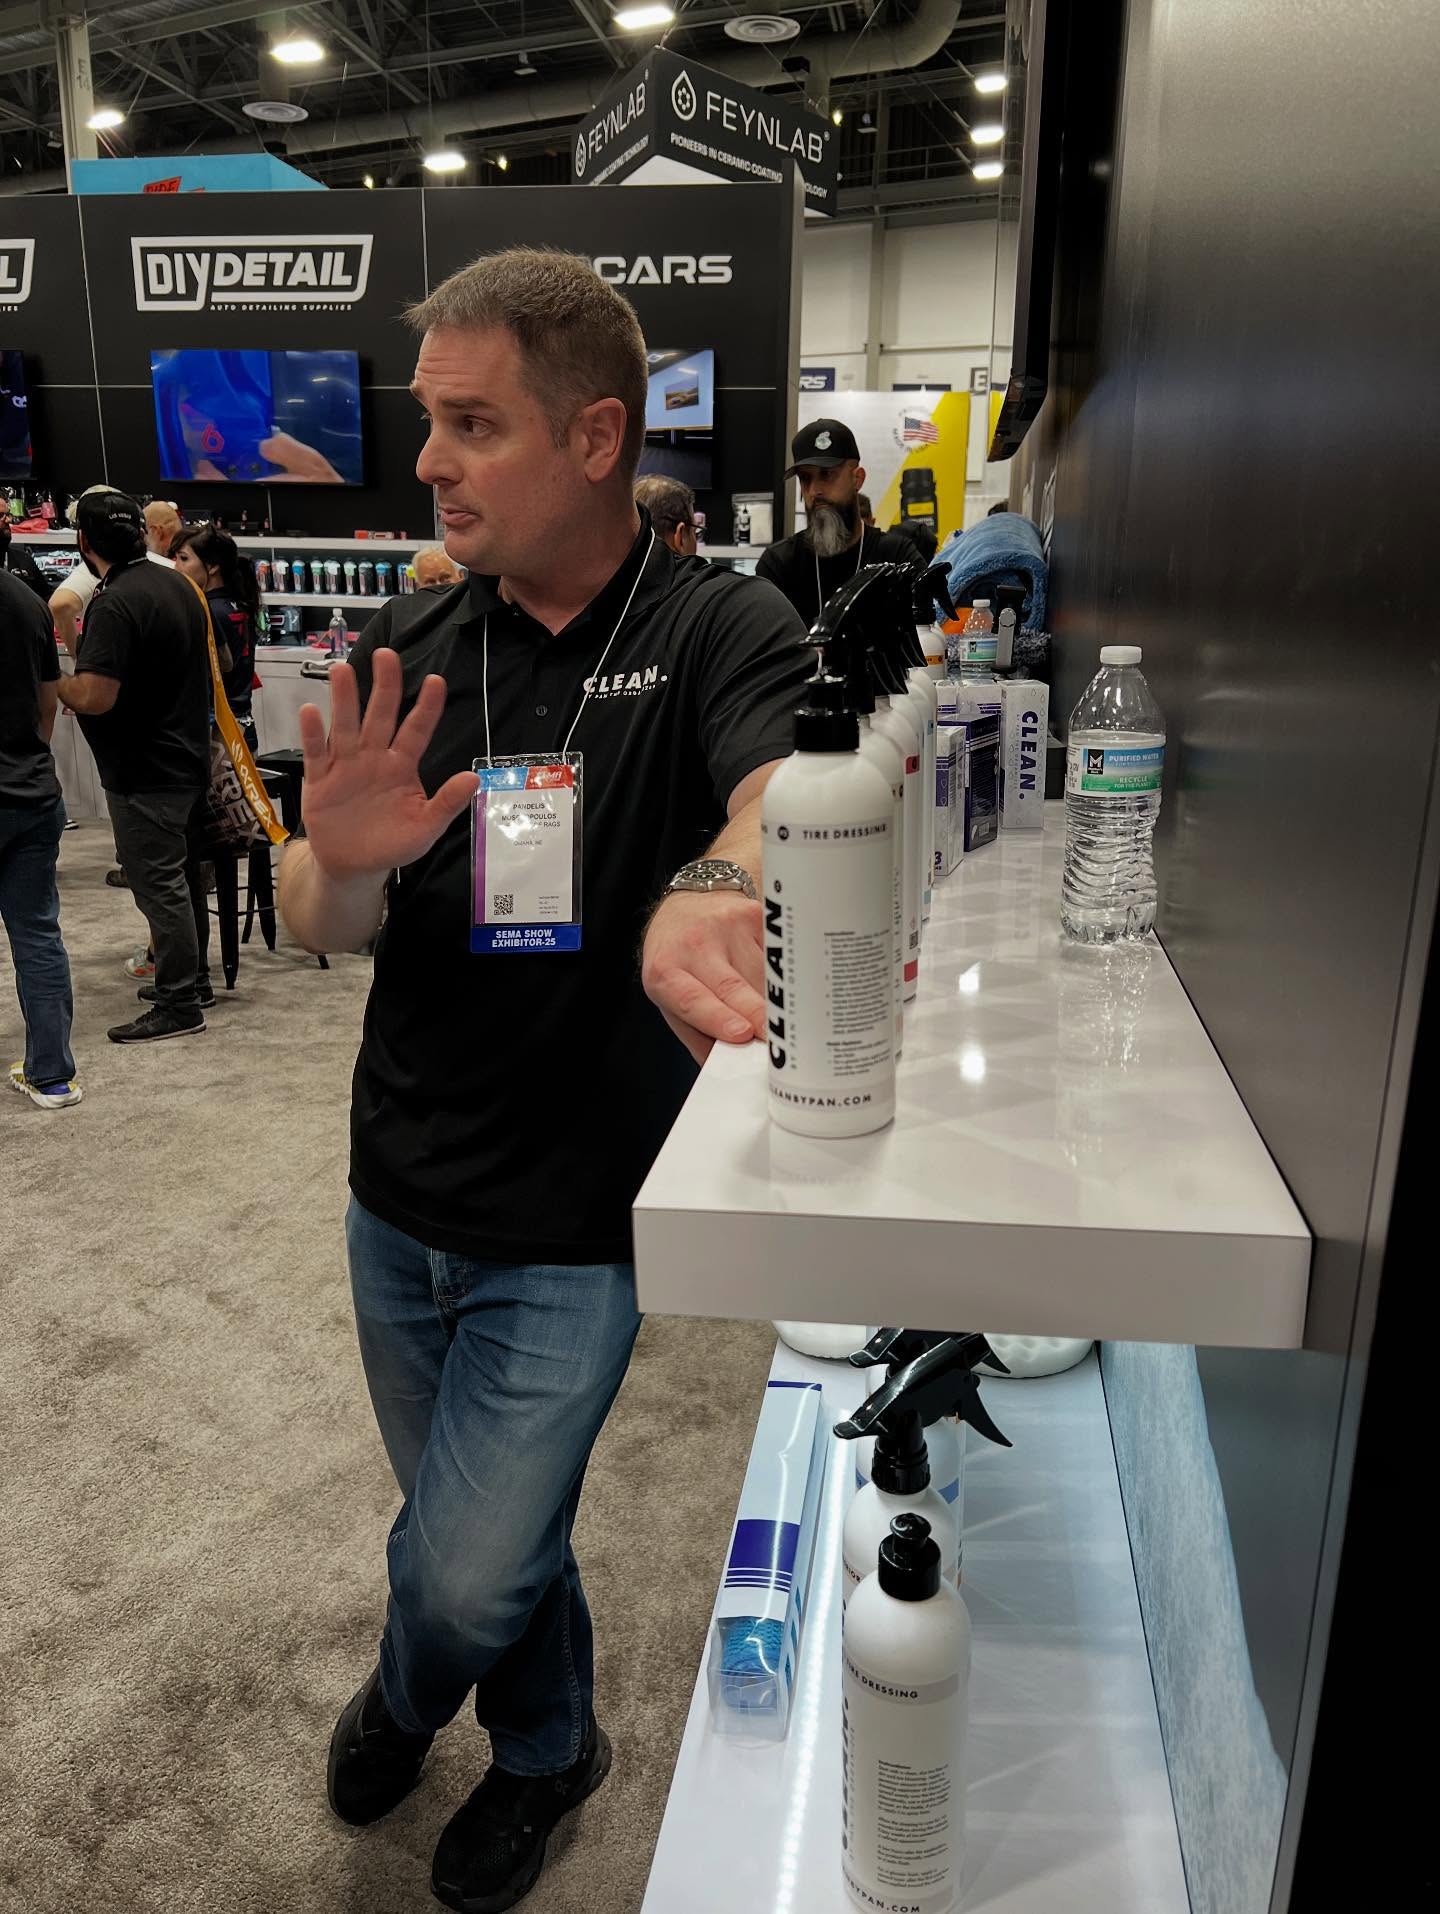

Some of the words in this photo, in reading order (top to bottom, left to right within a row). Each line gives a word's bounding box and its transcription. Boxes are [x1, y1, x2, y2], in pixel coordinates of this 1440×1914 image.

[718, 150, 751, 172] CERAMIC
[803, 829, 829, 840] TIRE
[833, 823, 887, 839] DRESSING
[492, 938, 556, 947] EXHIBITOR-25
[495, 930, 522, 939] SEMA
[524, 929, 553, 937] SHOW
[861, 1675, 919, 1699] DRESSING
